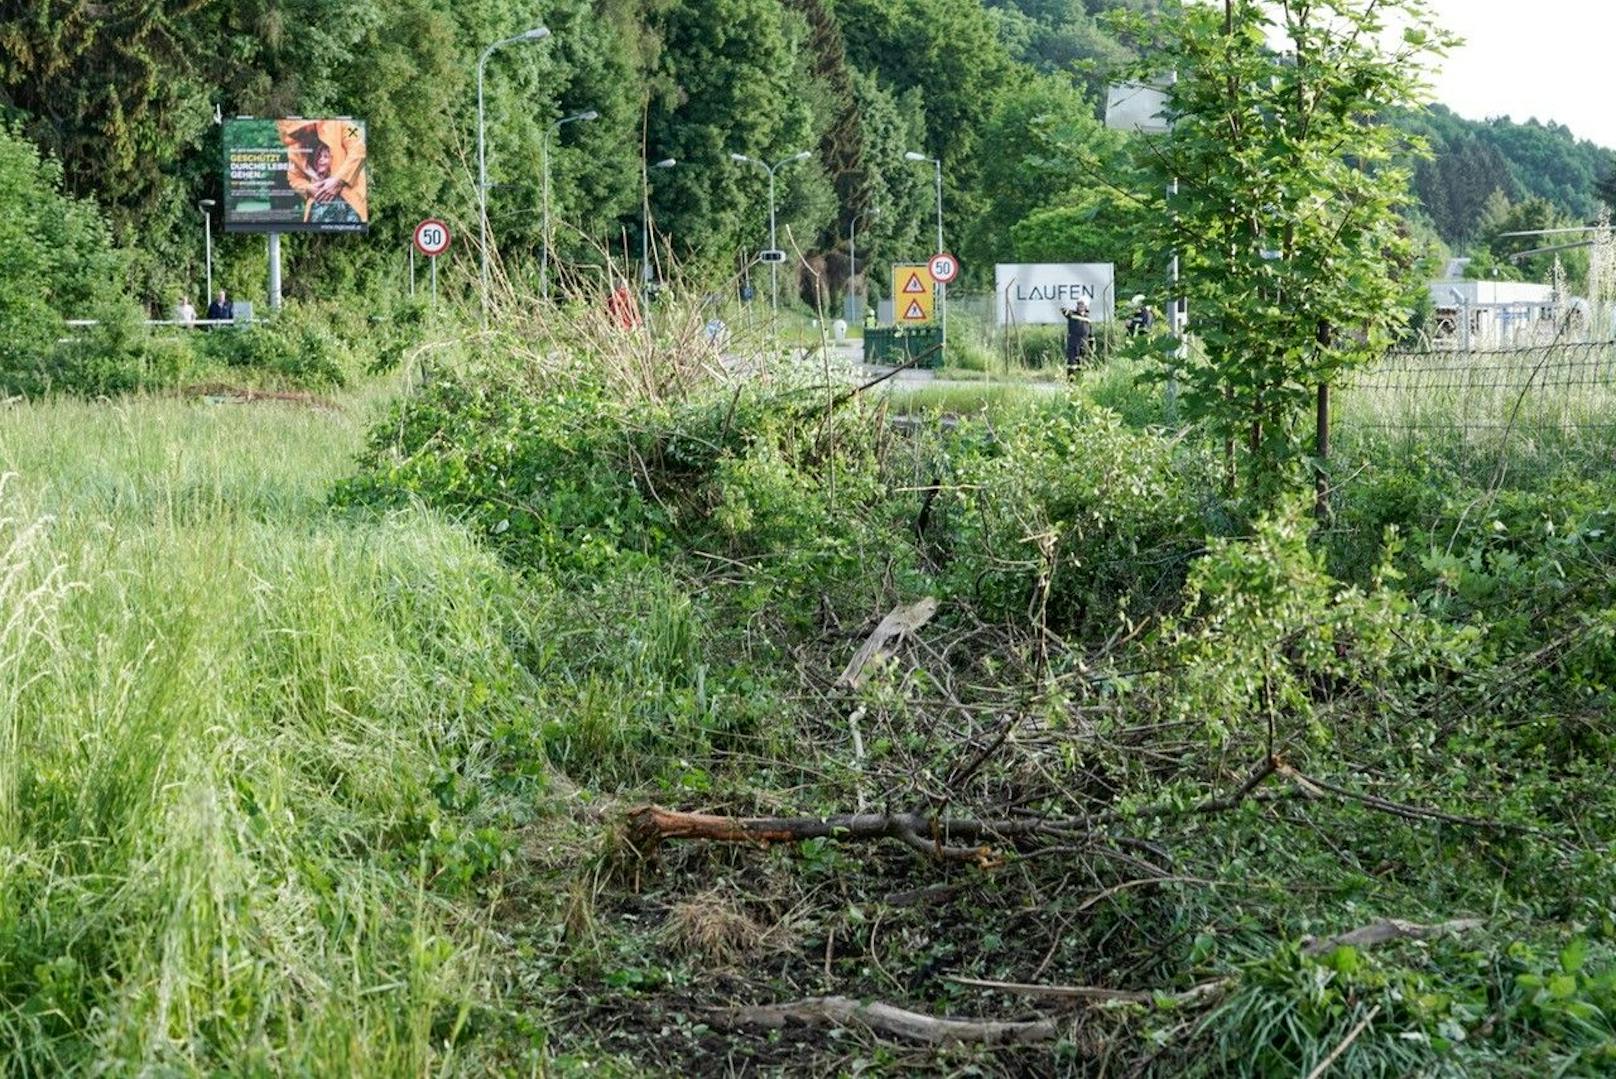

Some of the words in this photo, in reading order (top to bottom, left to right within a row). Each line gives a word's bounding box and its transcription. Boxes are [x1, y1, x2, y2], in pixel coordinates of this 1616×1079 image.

[230, 153, 280, 162] GESCHÜTZT
[230, 162, 266, 171] DURCHS
[424, 229, 441, 245] 50
[935, 261, 950, 275] 50
[1016, 284, 1094, 300] LAUFEN
